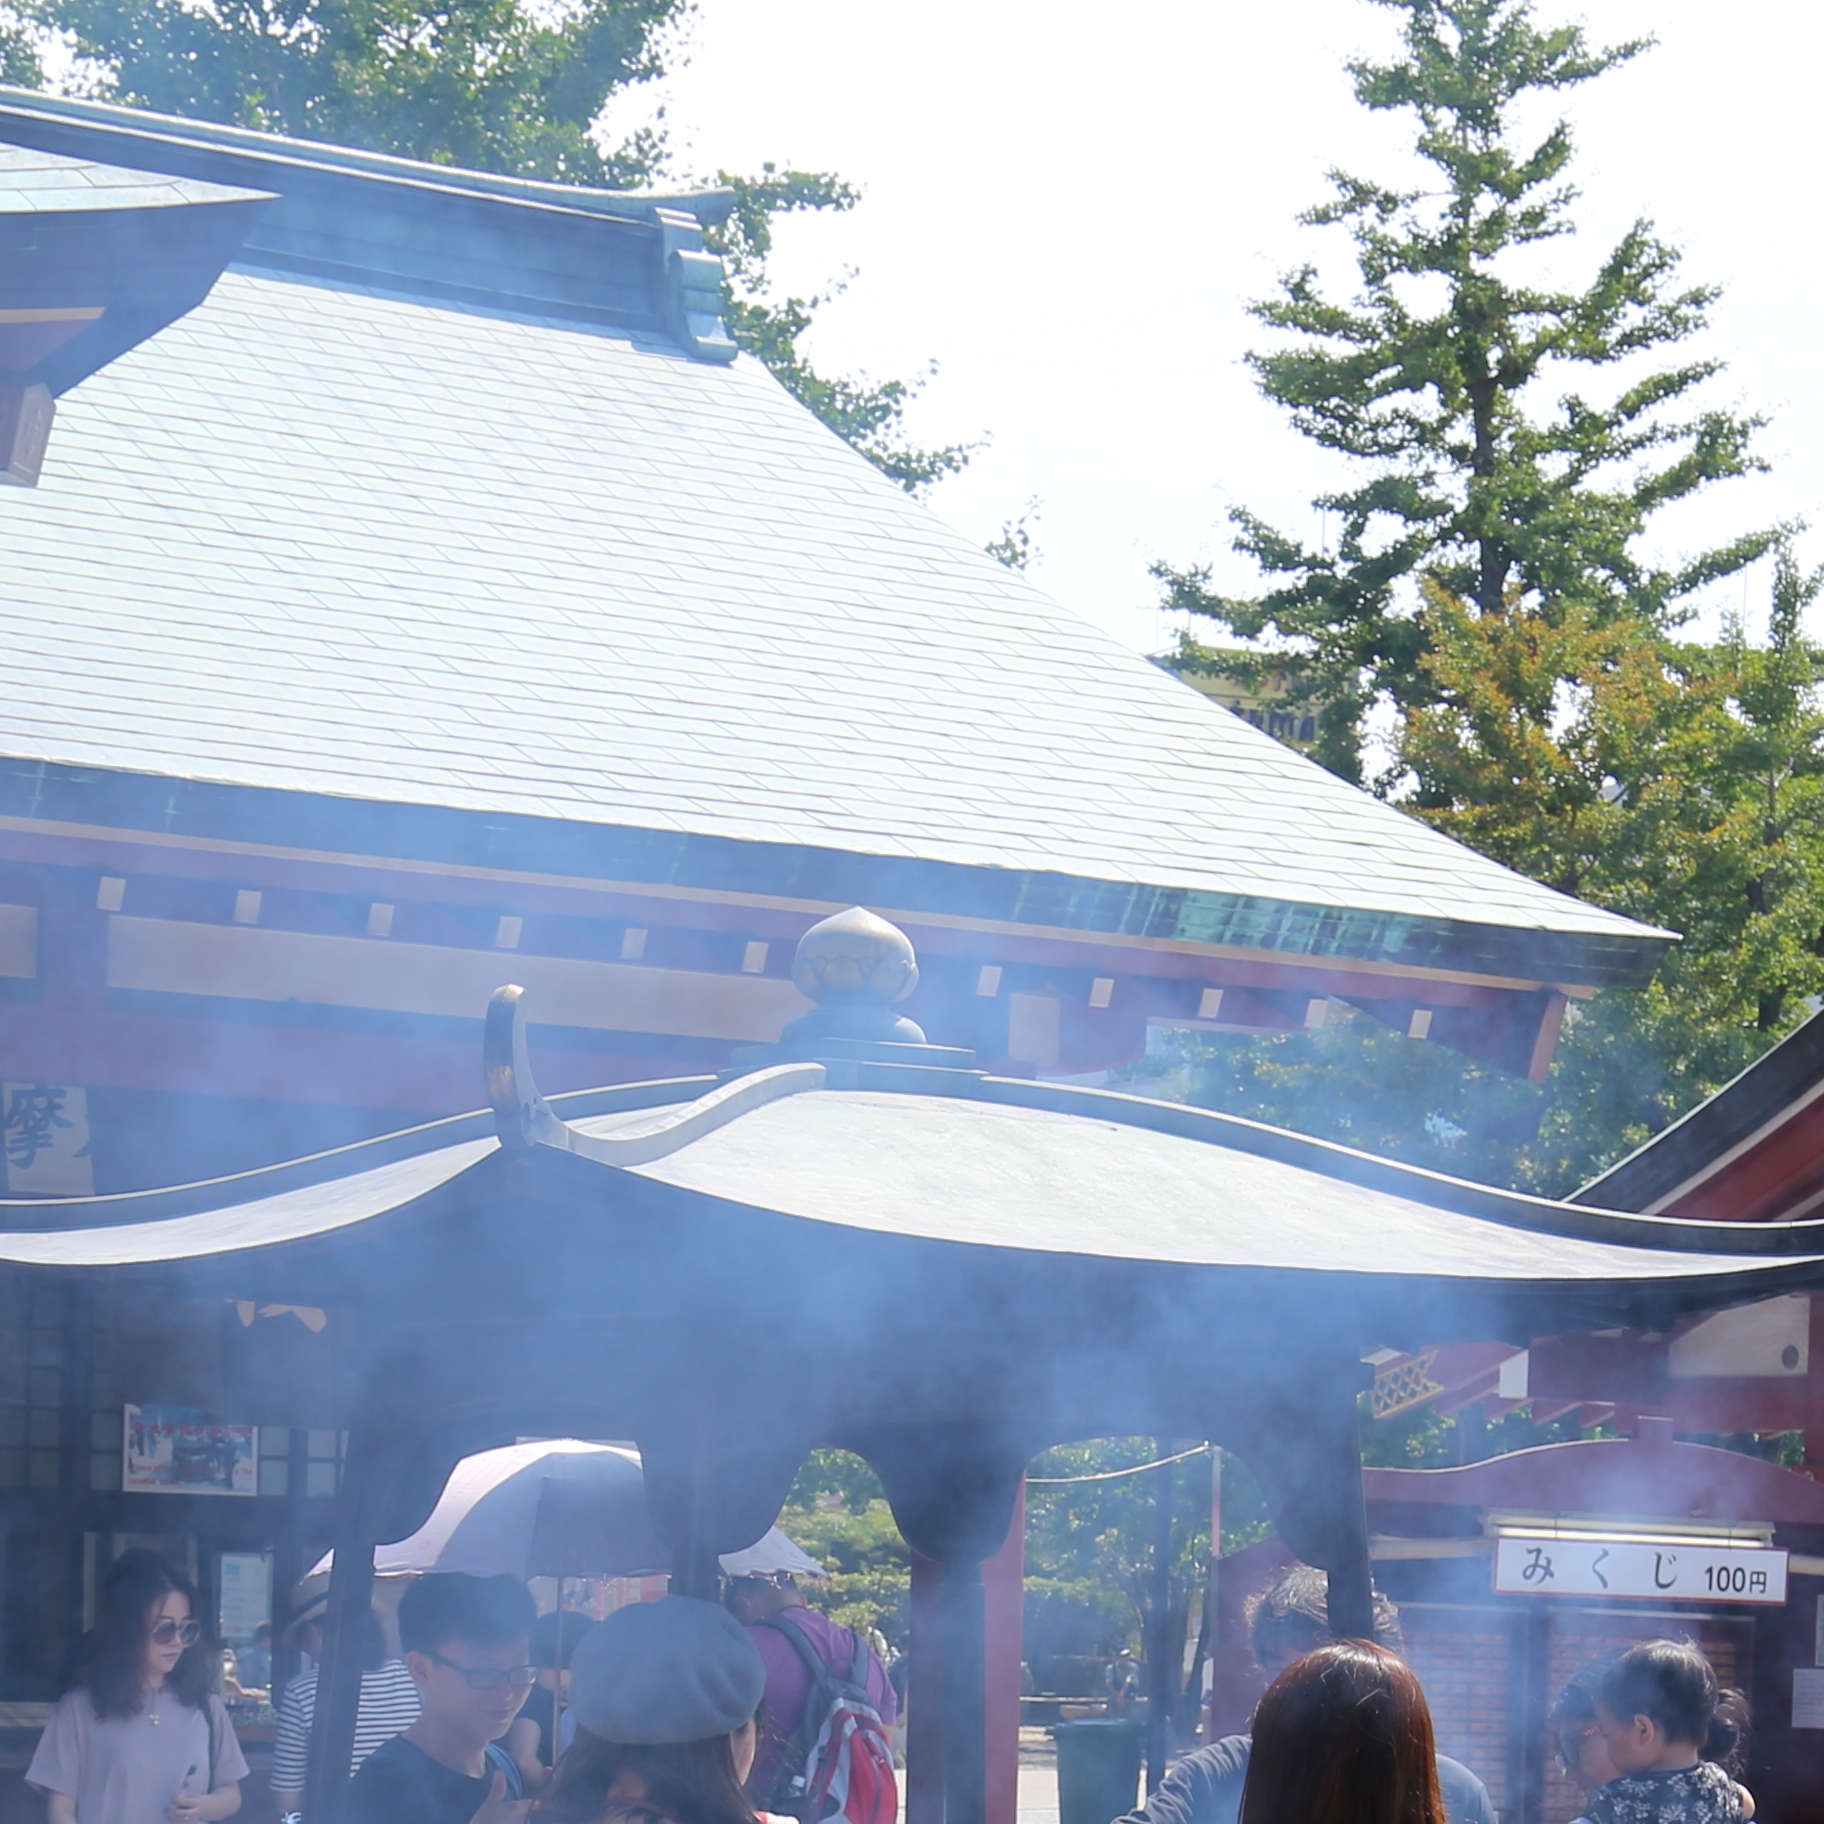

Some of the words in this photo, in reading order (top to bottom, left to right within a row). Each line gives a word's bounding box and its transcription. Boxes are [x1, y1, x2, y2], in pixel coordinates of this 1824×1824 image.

[1522, 1547, 1677, 1590] みくじ
[1704, 1564, 1768, 1595] 100円
